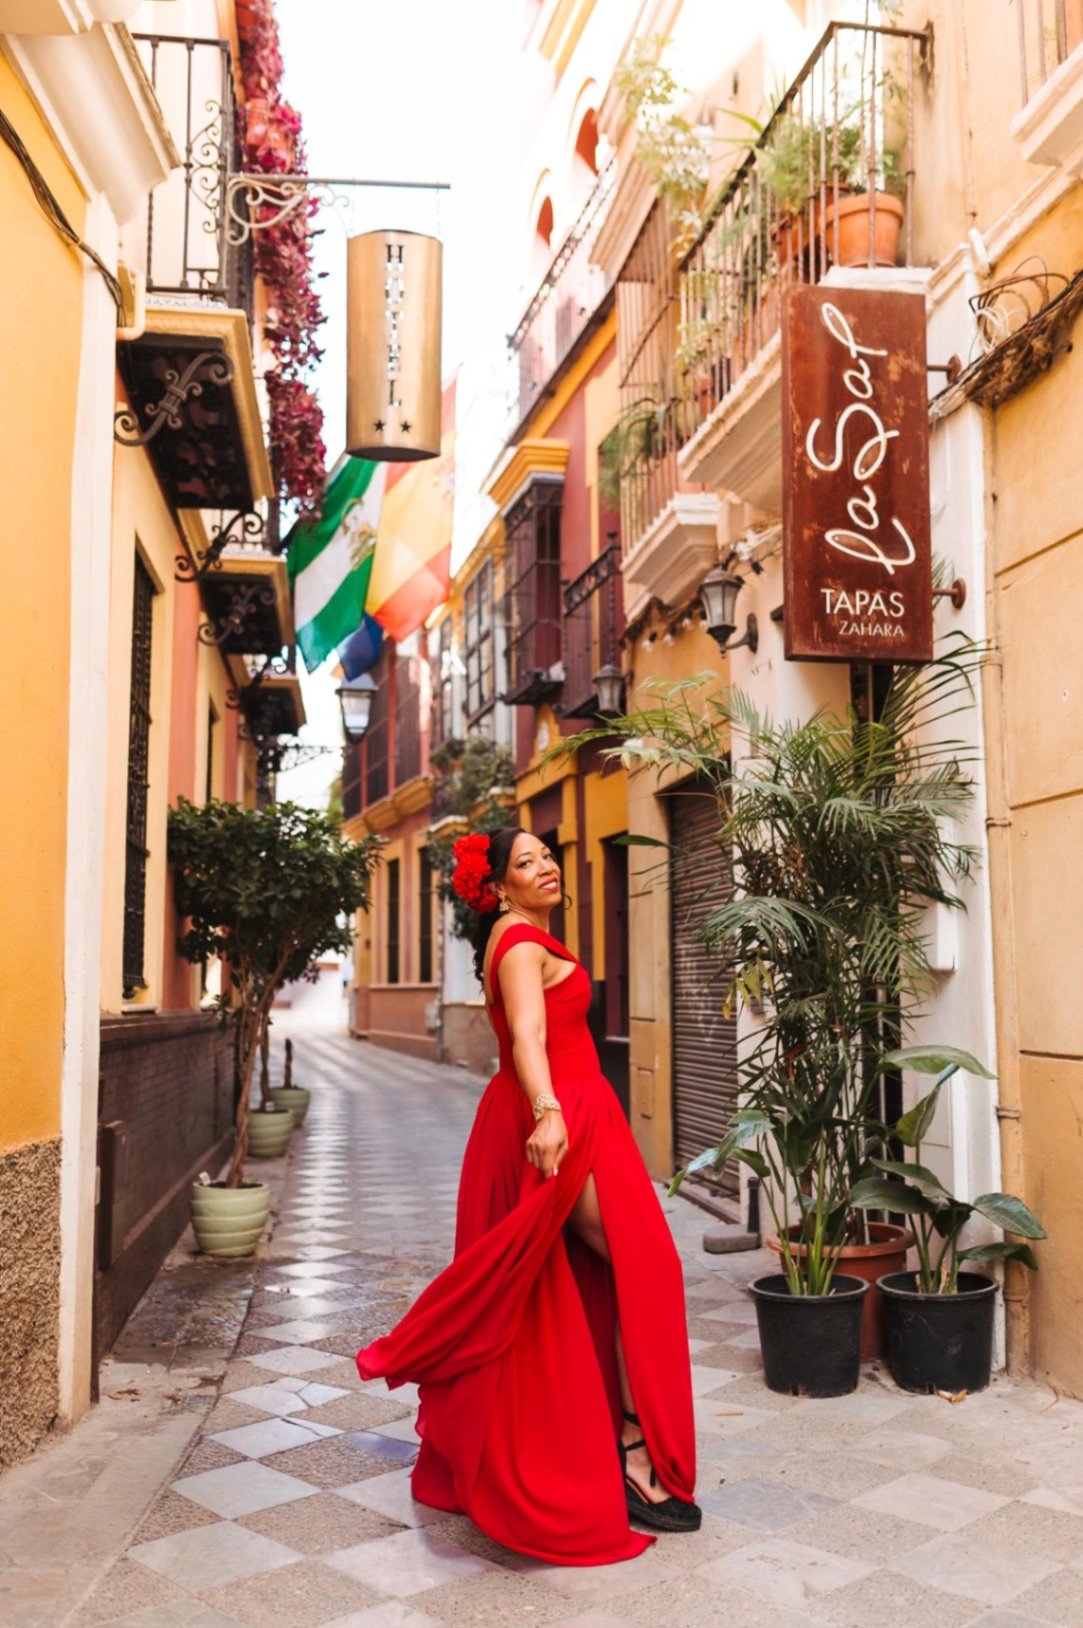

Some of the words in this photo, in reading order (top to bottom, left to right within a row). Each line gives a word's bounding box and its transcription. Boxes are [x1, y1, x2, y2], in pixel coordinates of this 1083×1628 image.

[385, 244, 405, 407] HOTEL
[820, 588, 905, 617] TAPAS
[839, 620, 905, 637] ZAHARA
